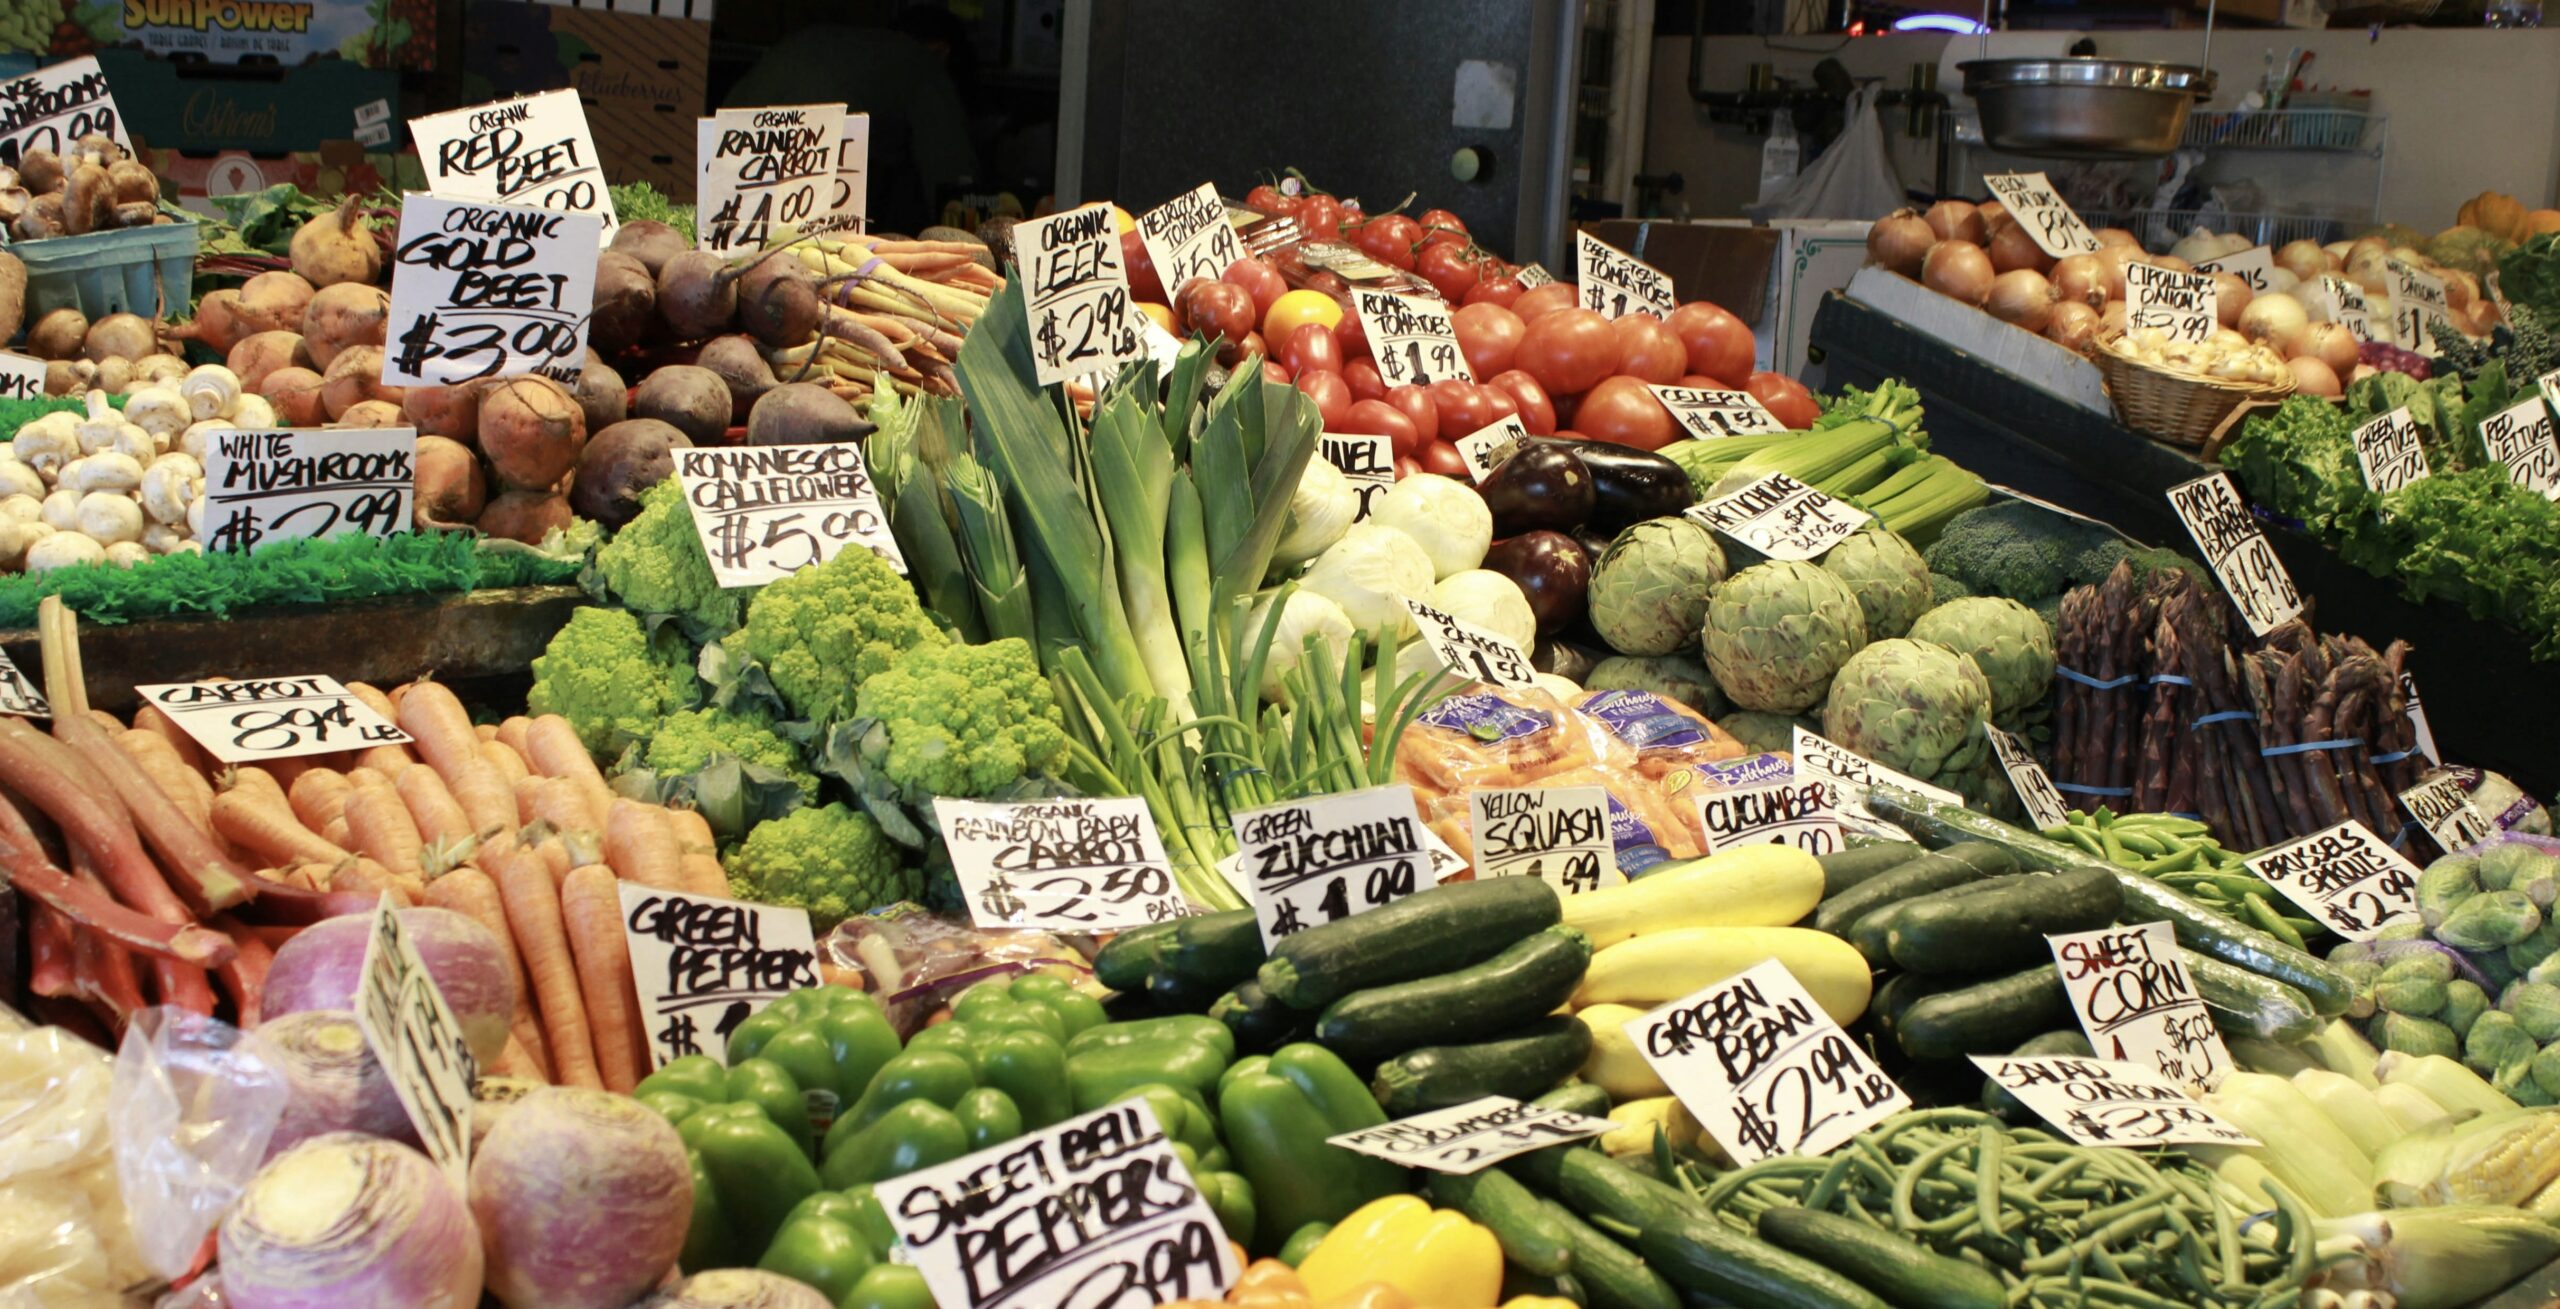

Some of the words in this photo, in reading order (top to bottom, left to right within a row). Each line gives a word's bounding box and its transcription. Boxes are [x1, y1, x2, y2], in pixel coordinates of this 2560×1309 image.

[468, 103, 535, 134] ORGANIC
[753, 110, 806, 128] ORGANIC
[438, 127, 523, 177] RED
[716, 125, 825, 158] RAINBOW
[496, 138, 582, 196] BEET
[739, 147, 830, 181] CARROT
[443, 207, 565, 240] ORGANIC
[1041, 208, 1111, 251] ORGANIC
[1142, 190, 1203, 239] HEIRLOOM
[1162, 199, 1223, 248] TOMATOES
[396, 232, 536, 271] GOLD
[1583, 238, 1614, 261] BEEF
[1034, 242, 1117, 297] LEEK
[448, 270, 569, 312] BEET
[1363, 293, 1411, 314] ROMA
[1112, 327, 1138, 357] LB
[1374, 314, 1453, 335] TOMATOES
[1660, 388, 1747, 406] CELERY
[219, 433, 294, 459] WHITE
[2358, 414, 2394, 453] GREEN
[2369, 420, 2416, 473] LETTUCE
[2486, 413, 2513, 446] RED
[2495, 416, 2550, 463] LETTUCE
[223, 449, 413, 490] MUSHROOMS
[682, 446, 861, 480] ROMANESCO
[1695, 472, 1804, 530] ARTICHOKE
[2175, 478, 2230, 527] PURPLE
[158, 677, 321, 704] CARROT
[360, 725, 407, 742] LB
[1800, 735, 1869, 773] ENGLISH
[1008, 803, 1101, 819] ORGANIC
[1480, 790, 1544, 821] YELLOW
[1705, 780, 1836, 834] CUCUMBER
[954, 817, 1064, 843] RAINBOW
[1076, 814, 1141, 841] BABY
[1243, 808, 1313, 845] GREEN
[1484, 805, 1605, 856] SQUASH
[992, 838, 1146, 872] CARROT
[2258, 826, 2366, 881] BRUSSELS
[2299, 845, 2388, 894] SPROUTS
[629, 896, 760, 948] GREEN
[1145, 896, 1188, 922] BAG
[668, 944, 819, 995] PEPPERS
[2061, 928, 2154, 980] SWEET
[2087, 959, 2188, 1025] CORN
[1647, 977, 1769, 1058] GREEN
[1713, 997, 1815, 1086] BEAN
[1854, 1073, 1895, 1109] LB
[1998, 1059, 2112, 1089] SALAD
[2063, 1081, 2185, 1102] ONION
[898, 1140, 1055, 1249] SWEET
[954, 1154, 1197, 1308] PEPPERS
